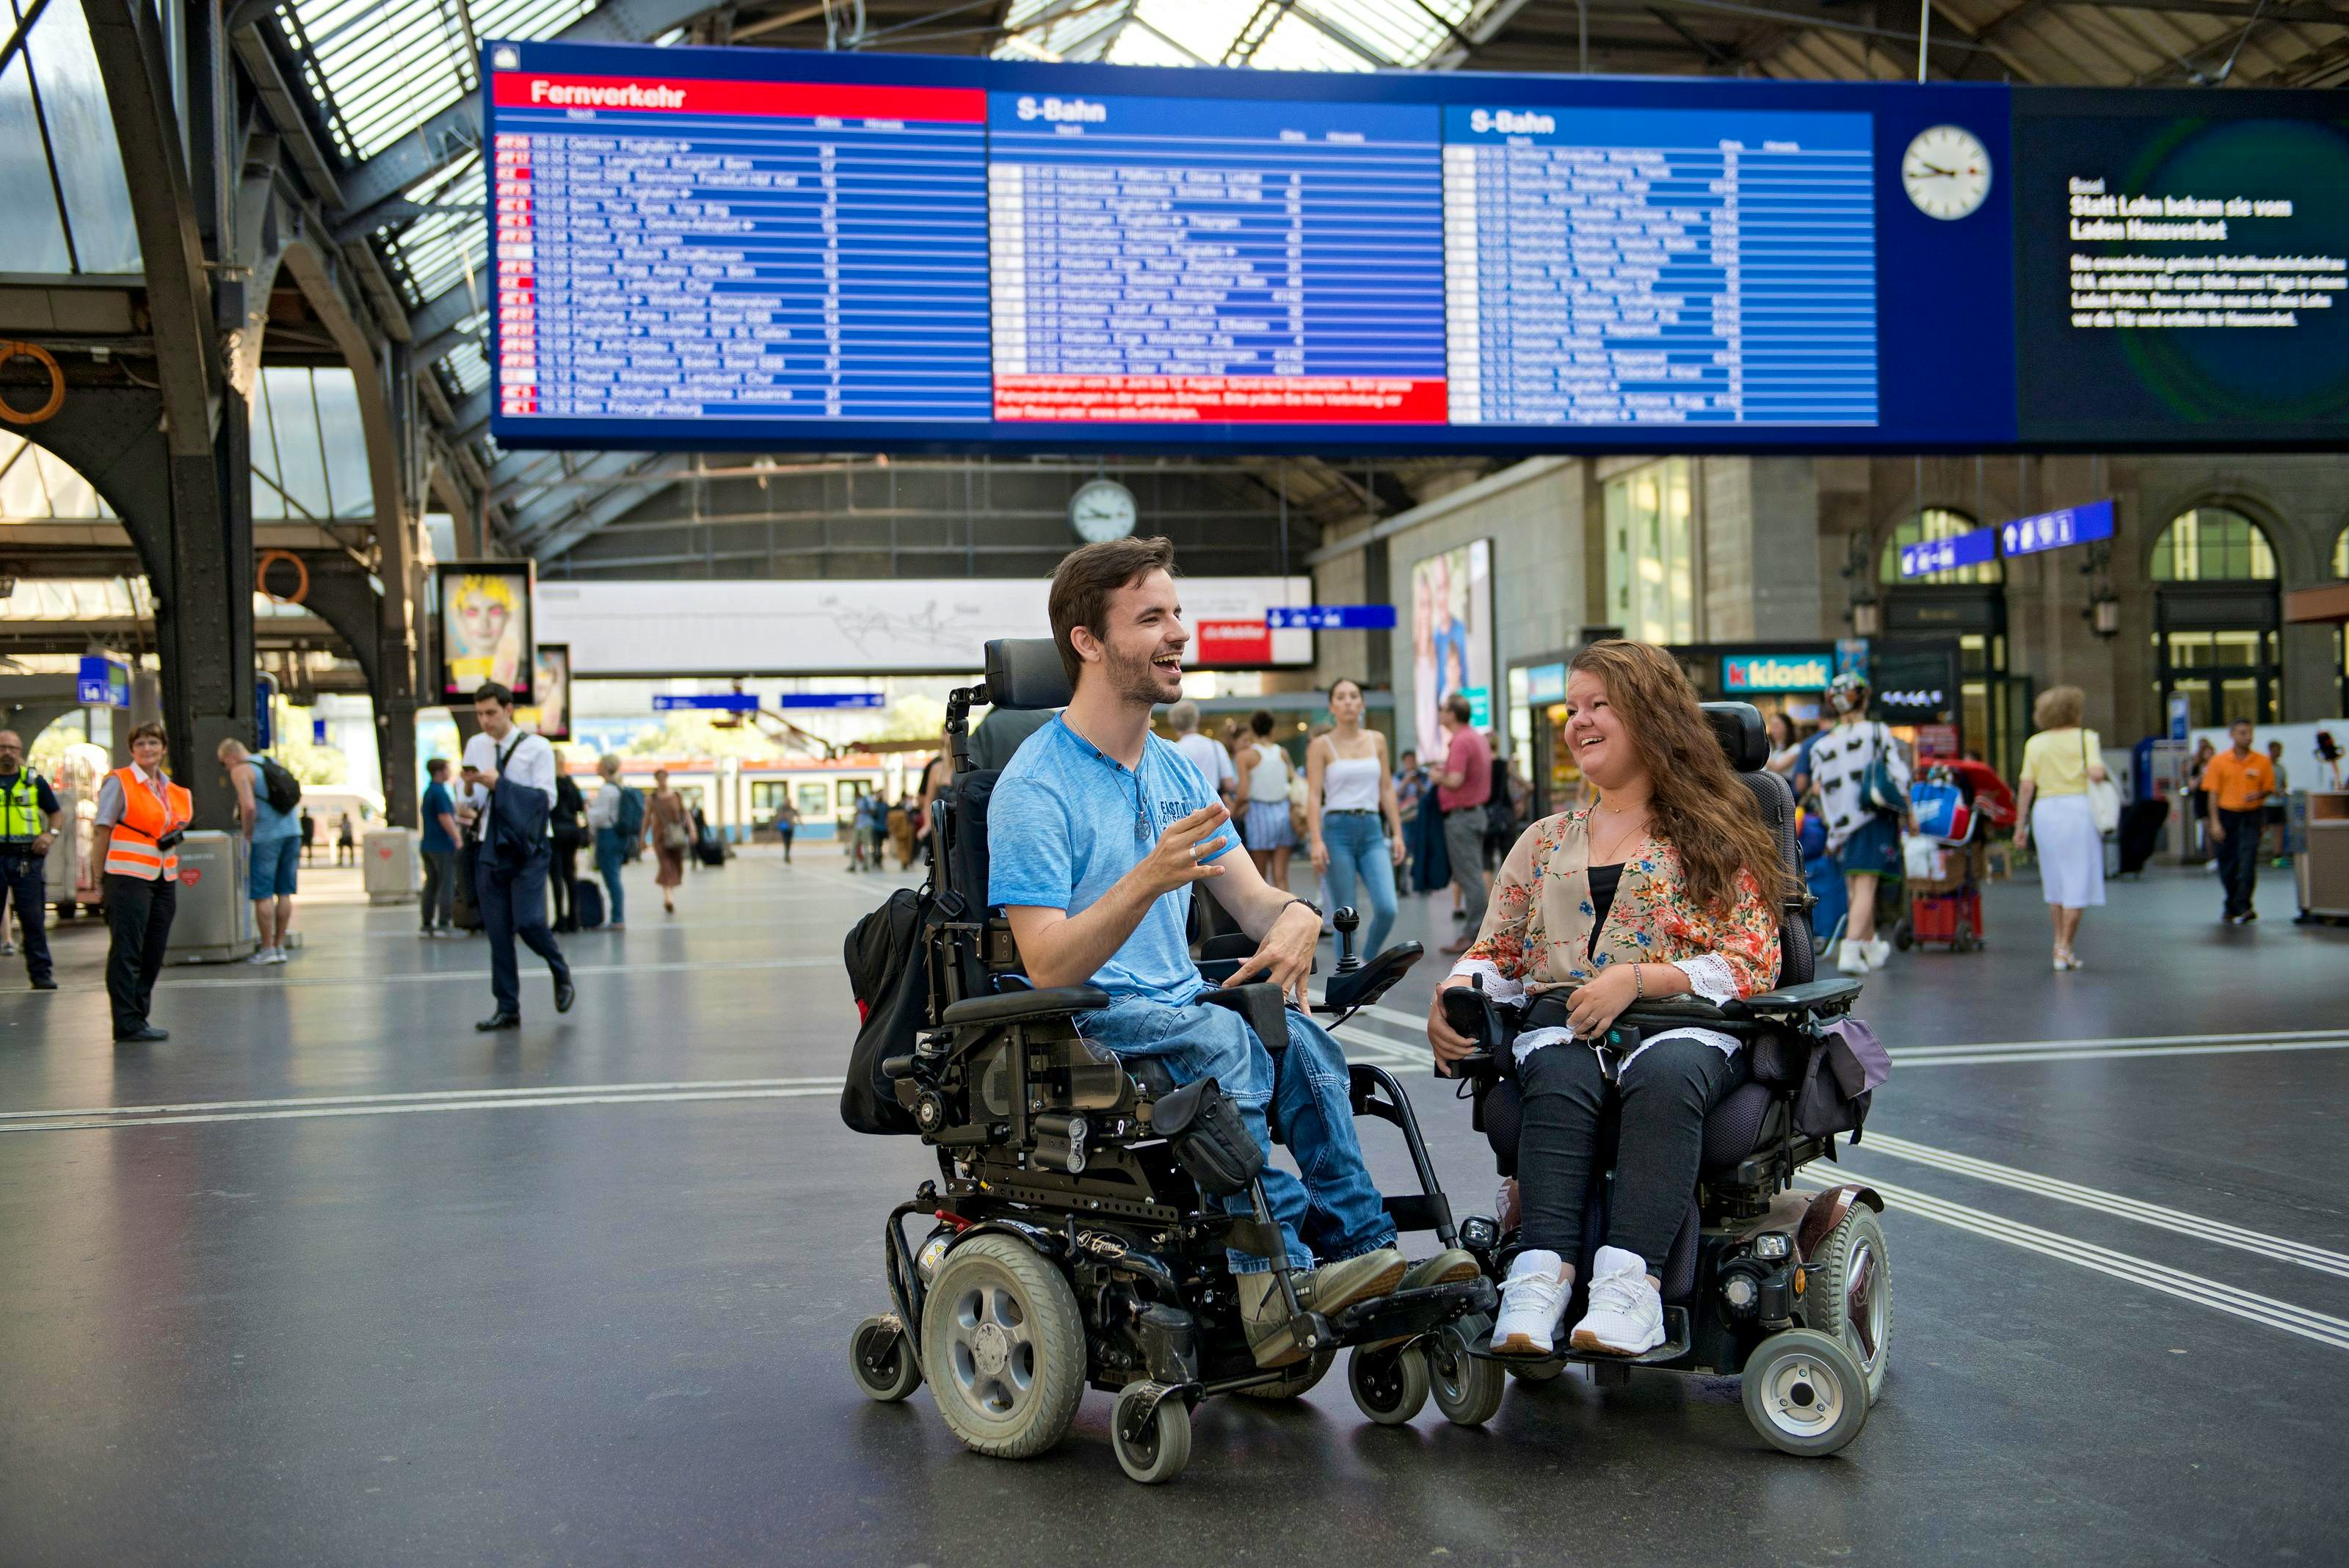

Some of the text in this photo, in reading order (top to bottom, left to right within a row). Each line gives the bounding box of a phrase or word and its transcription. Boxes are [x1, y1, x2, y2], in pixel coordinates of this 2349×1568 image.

[531, 80, 686, 108] Fernverkehr
[1017, 96, 1106, 122] S-Bahn
[1470, 109, 1555, 134] S-Bahn
[2069, 194, 2293, 217] Statt Lohn bekam sie vom
[2070, 218, 2228, 241] Laden Hausverbot
[1729, 660, 1826, 686] k kiosk
[1161, 800, 1180, 816] EAST
